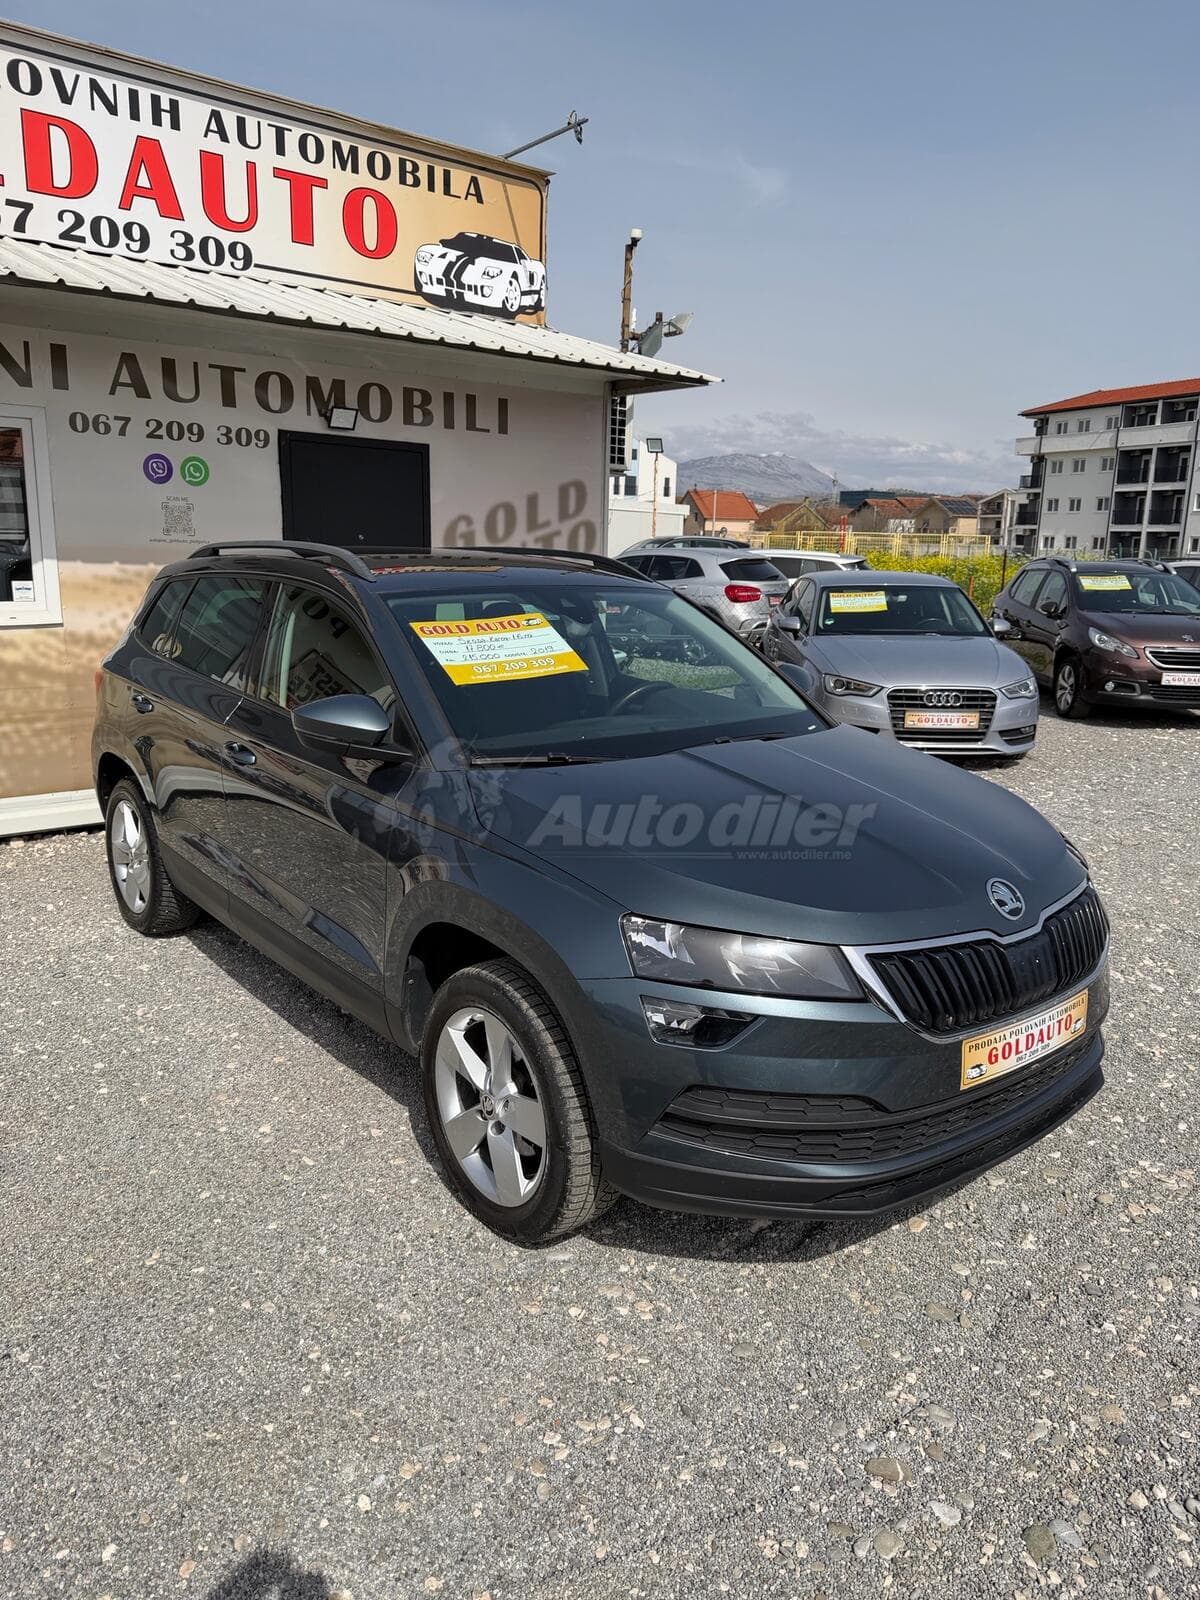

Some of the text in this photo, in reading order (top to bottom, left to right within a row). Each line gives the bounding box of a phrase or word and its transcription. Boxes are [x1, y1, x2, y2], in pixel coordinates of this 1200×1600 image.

[0, 58, 485, 205] OVNIH AUTOMOBILA
[0, 107, 399, 260] DAUTO
[0, 198, 254, 272] 7 209 309
[108, 351, 509, 436] AUTOMOBILI
[68, 411, 271, 449] 067 209 309
[443, 478, 588, 549] GOLD
[419, 619, 521, 636] GOLD AUTO
[472, 664, 498, 674] 067
[502, 661, 528, 671] 209
[530, 657, 556, 667] 309
[968, 997, 1085, 1053] PRODAJA POLOVNIH AUTOMOBILA
[987, 1013, 1073, 1065] GOLDAUTO
